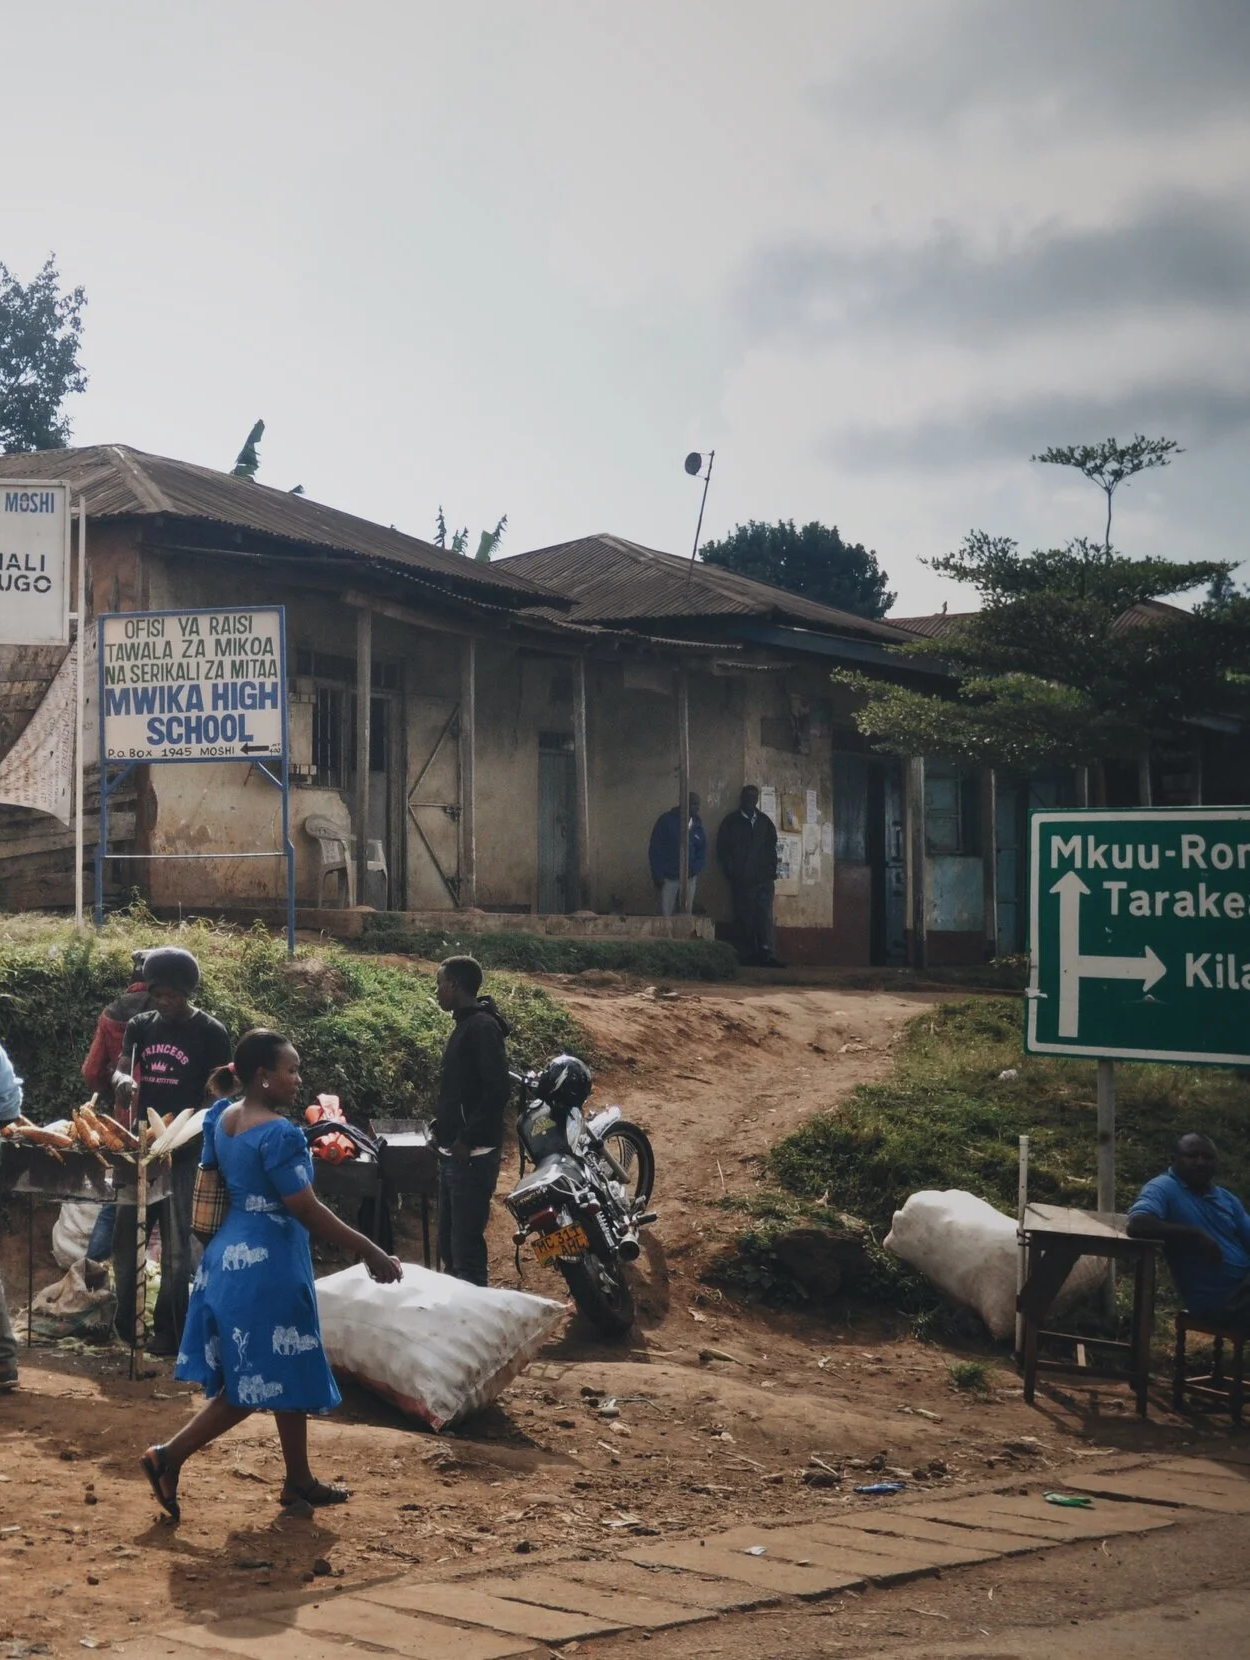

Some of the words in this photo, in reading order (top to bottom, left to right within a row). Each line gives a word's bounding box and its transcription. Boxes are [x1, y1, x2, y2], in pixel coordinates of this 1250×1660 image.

[5, 492, 55, 514] MOSHI
[124, 618, 165, 639] OFISI
[178, 616, 200, 637] YA
[209, 615, 253, 636] RAISI
[105, 640, 173, 663] TAWALA
[182, 639, 206, 659] ZA
[215, 637, 274, 657] MIKOA
[105, 665, 126, 685] NA
[130, 661, 200, 684] SERIKALI
[204, 660, 225, 681] ZA
[231, 659, 278, 679] MITAA
[105, 683, 204, 717] MWIKA
[211, 681, 279, 711] HIGH
[146, 713, 254, 745] SCHOOL
[162, 747, 192, 757] 1945
[200, 746, 235, 756] MOSHI
[1102, 881, 1250, 919] Tarake
